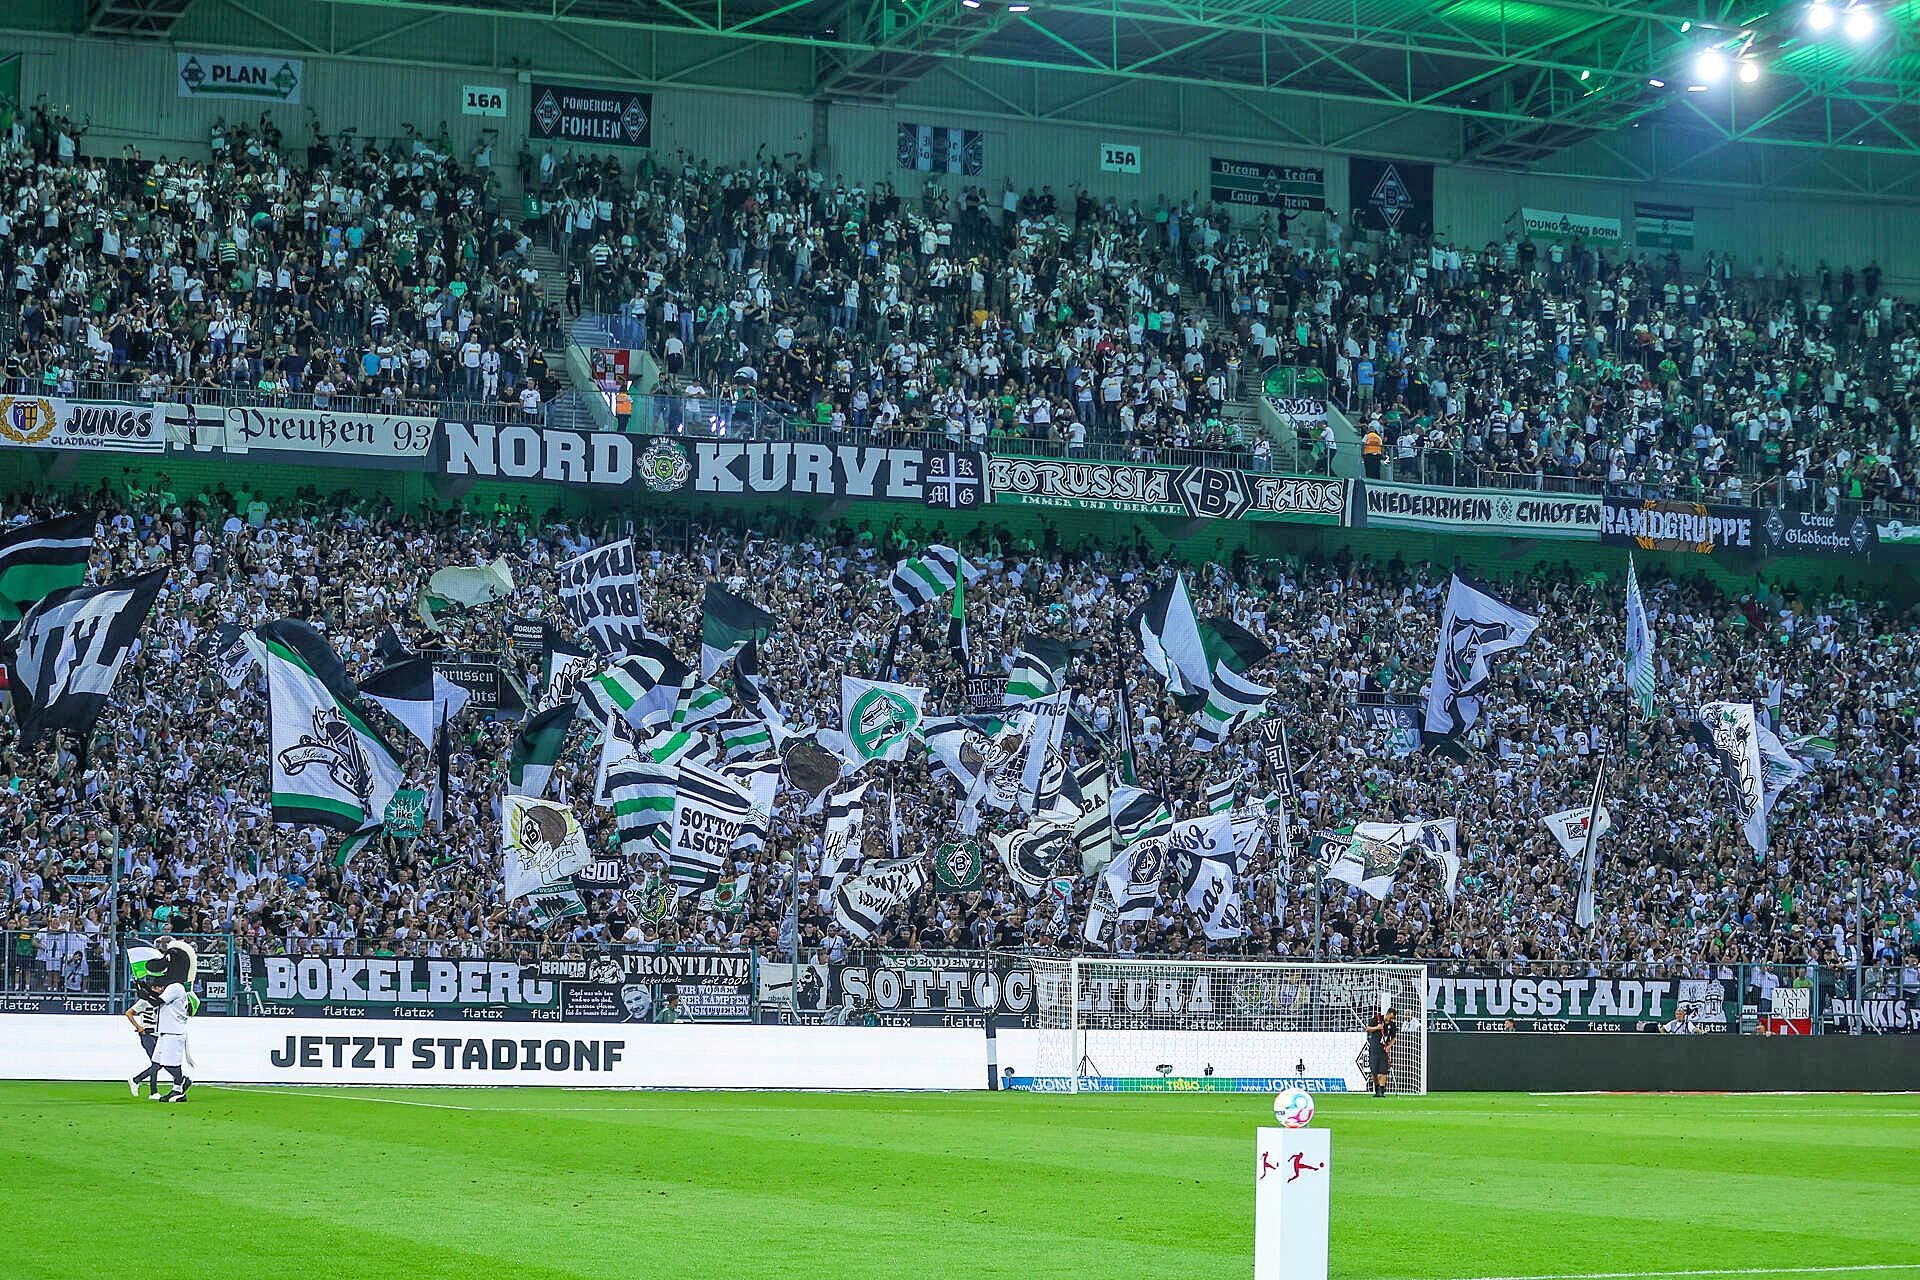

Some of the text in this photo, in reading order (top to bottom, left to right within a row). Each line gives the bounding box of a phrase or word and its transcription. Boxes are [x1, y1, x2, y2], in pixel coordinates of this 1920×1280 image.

[212, 65, 267, 85] PLAN
[467, 92, 502, 109] 16A
[562, 97, 622, 114] PONDEROSA
[561, 116, 621, 139] FOHLEN
[1105, 150, 1137, 166] 15A
[65, 406, 153, 438] JUNGS
[228, 407, 375, 449] Preußen
[51, 436, 104, 448] GLADBACH
[445, 423, 924, 499] NORD KURVE
[989, 458, 1169, 504] BORUSSIA
[1256, 478, 1344, 513] FANS
[1021, 495, 1072, 507] IMMER
[1080, 500, 1105, 510] UND
[1367, 490, 1600, 525] NIEDERRHEIN CHAOTEN
[1600, 505, 1750, 547] RANDGRUPPE
[1800, 512, 1834, 527] Treue
[1785, 529, 1850, 550] Gladbacher
[541, 961, 586, 974] BANDA
[622, 955, 749, 978] FRONTLINE
[884, 956, 994, 969] ASCENDENTE
[264, 954, 553, 1004] BÖKELBERG
[208, 986, 225, 994] 17/2
[676, 985, 738, 995] WIR WOLLEN
[1427, 978, 1671, 1017] VITUSSTADT
[1775, 989, 1807, 998] YANN
[63, 1002, 106, 1012] flatex
[323, 1005, 365, 1016] flatex
[1783, 998, 1800, 1008] IST
[393, 1007, 434, 1017] flatex
[462, 1007, 503, 1018] flatex
[1773, 1008, 1808, 1018] SUPER
[1100, 1018, 1149, 1030] flatex
[1177, 1019, 1225, 1031] flatex
[1252, 1019, 1299, 1031] flatex
[1533, 1022, 1566, 1032] flatex
[1588, 1022, 1621, 1032] flatex
[270, 1035, 626, 1072] JETZT STADIONF
